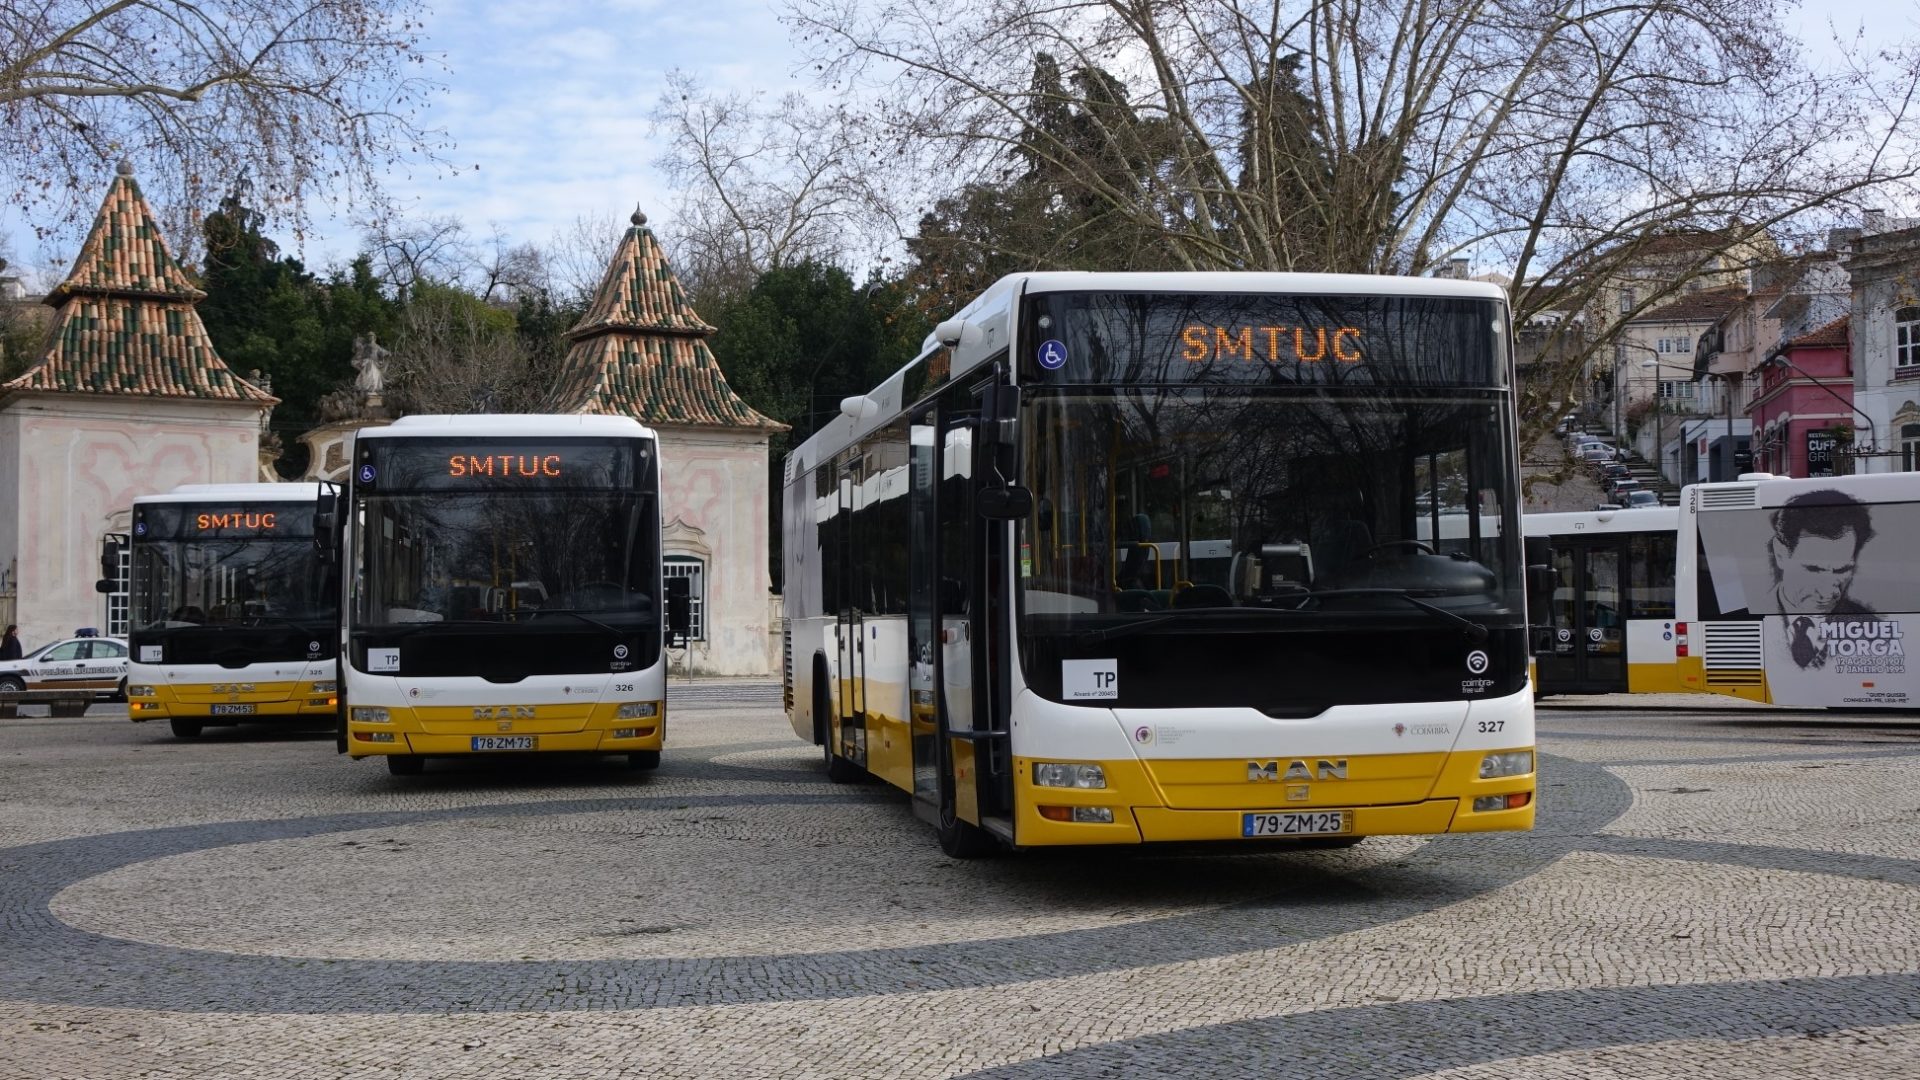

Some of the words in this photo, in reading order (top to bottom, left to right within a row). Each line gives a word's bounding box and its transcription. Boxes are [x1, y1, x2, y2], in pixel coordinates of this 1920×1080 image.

[1183, 325, 1361, 361] SMTUC
[449, 455, 560, 476] SMTUC
[1689, 488, 1697, 514] 328
[197, 513, 275, 529] SMTUC
[1820, 621, 1904, 639] MIGUEL
[152, 650, 162, 658] TP
[1827, 639, 1904, 656] TORGA
[385, 655, 399, 665] TP
[1846, 657, 1883, 666] AGOSTO
[1846, 665, 1884, 673] JANEIRO
[1885, 665, 1905, 673] 1995
[1093, 671, 1116, 688] TP
[615, 684, 634, 692] 326
[472, 706, 536, 720] MAN
[1478, 721, 1505, 733] 327
[1247, 759, 1348, 781] MAN
